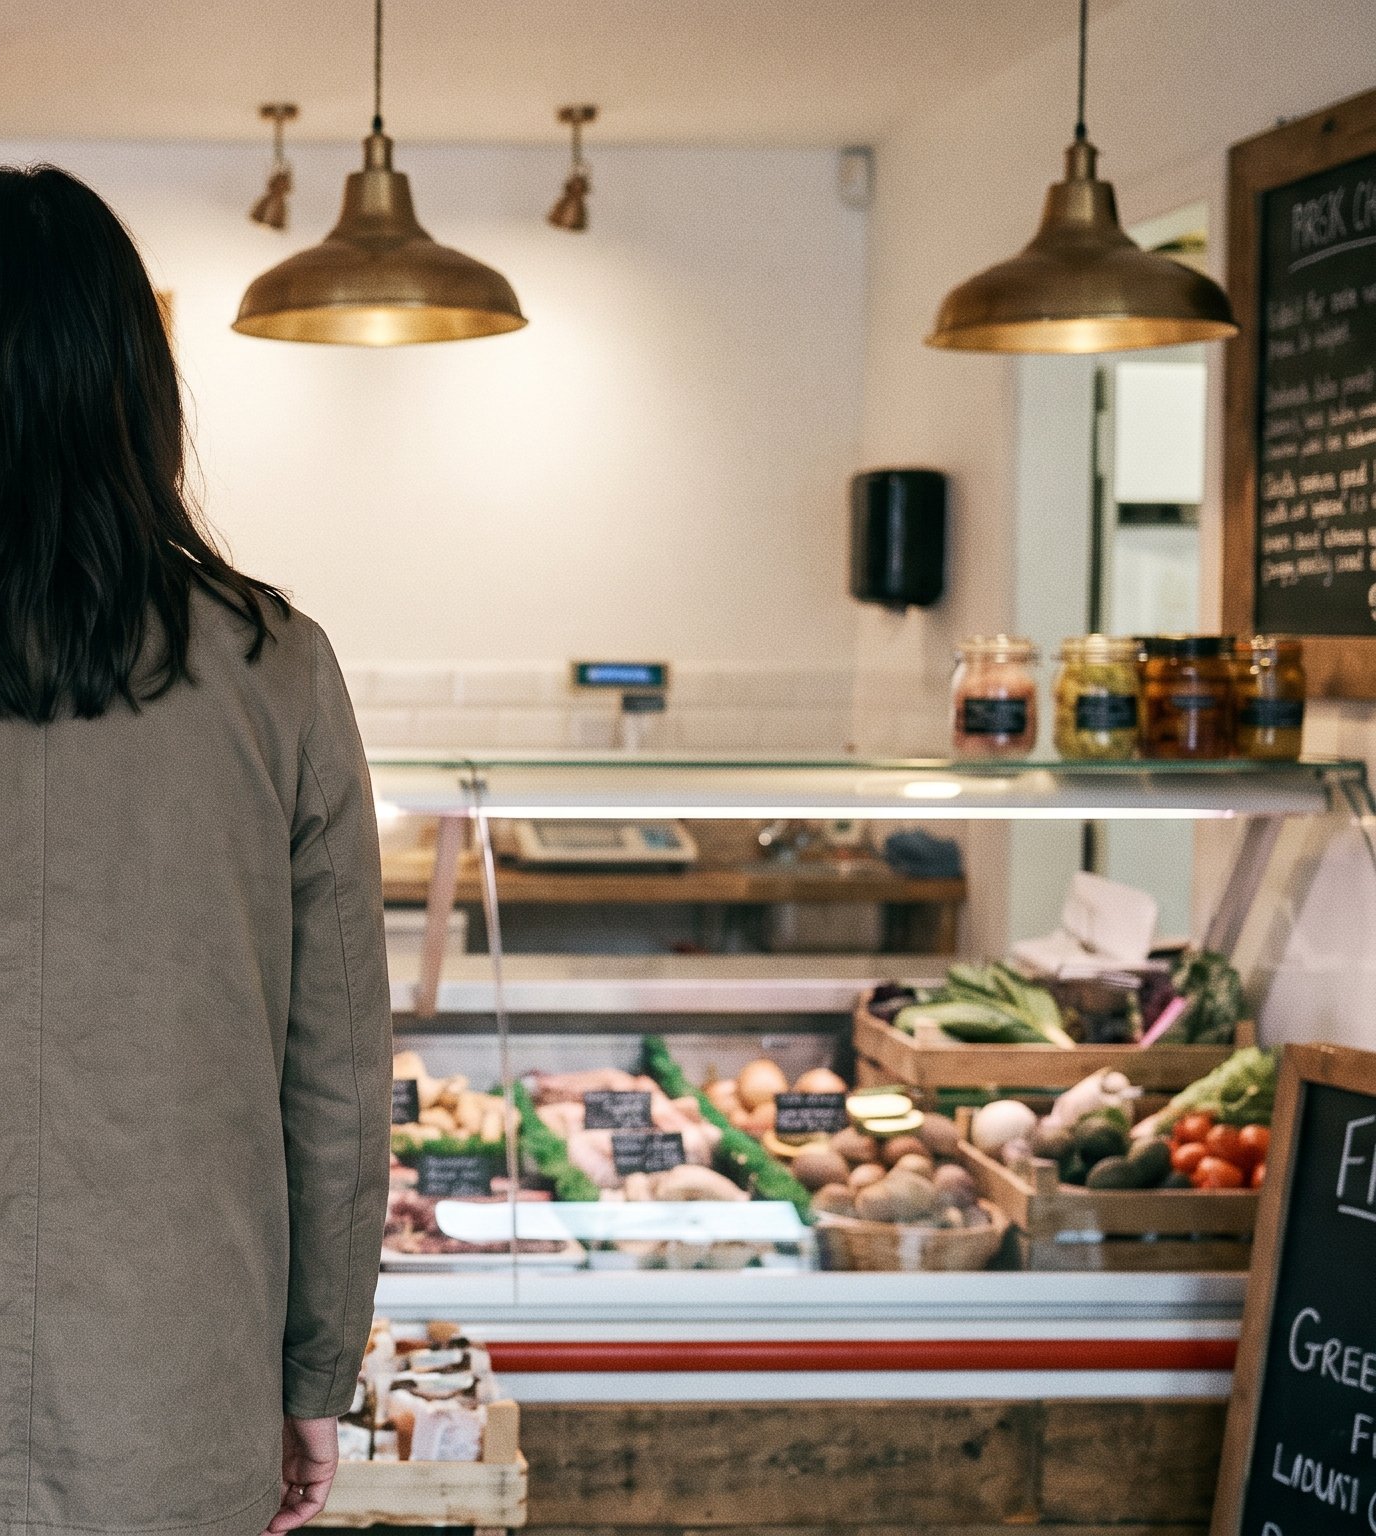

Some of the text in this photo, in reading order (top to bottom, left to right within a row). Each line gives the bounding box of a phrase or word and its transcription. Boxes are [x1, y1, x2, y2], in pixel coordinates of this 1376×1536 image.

[1336, 1115, 1376, 1204] F
[1289, 1307, 1376, 1393] GREE
[1350, 1412, 1376, 1459] F
